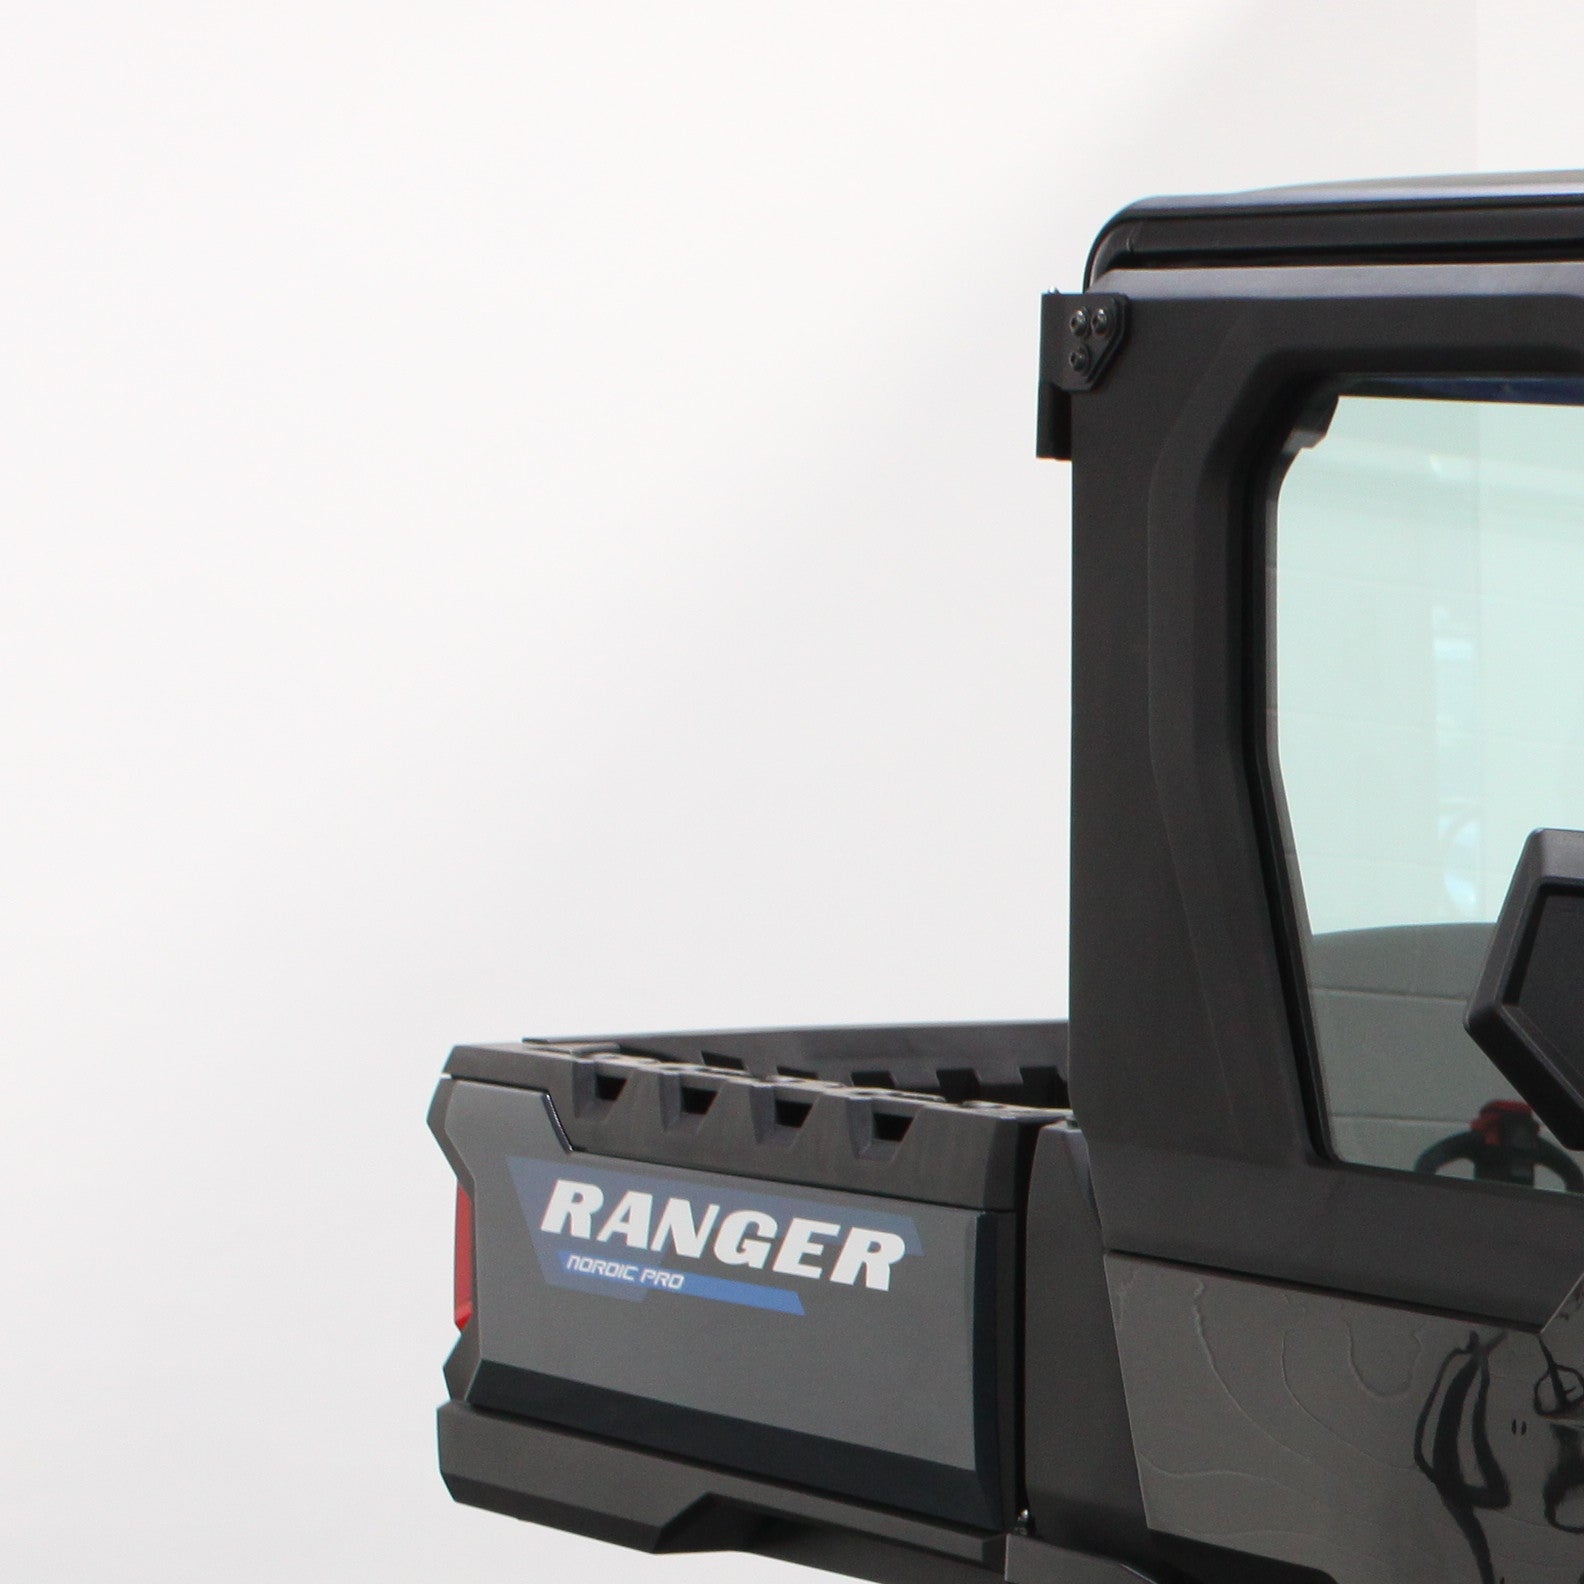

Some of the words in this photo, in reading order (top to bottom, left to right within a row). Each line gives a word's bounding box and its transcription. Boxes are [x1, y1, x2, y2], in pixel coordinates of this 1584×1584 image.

[539, 1178, 906, 1292] RANGER
[564, 1255, 637, 1280] NORDIC
[640, 1269, 685, 1290] PRO
